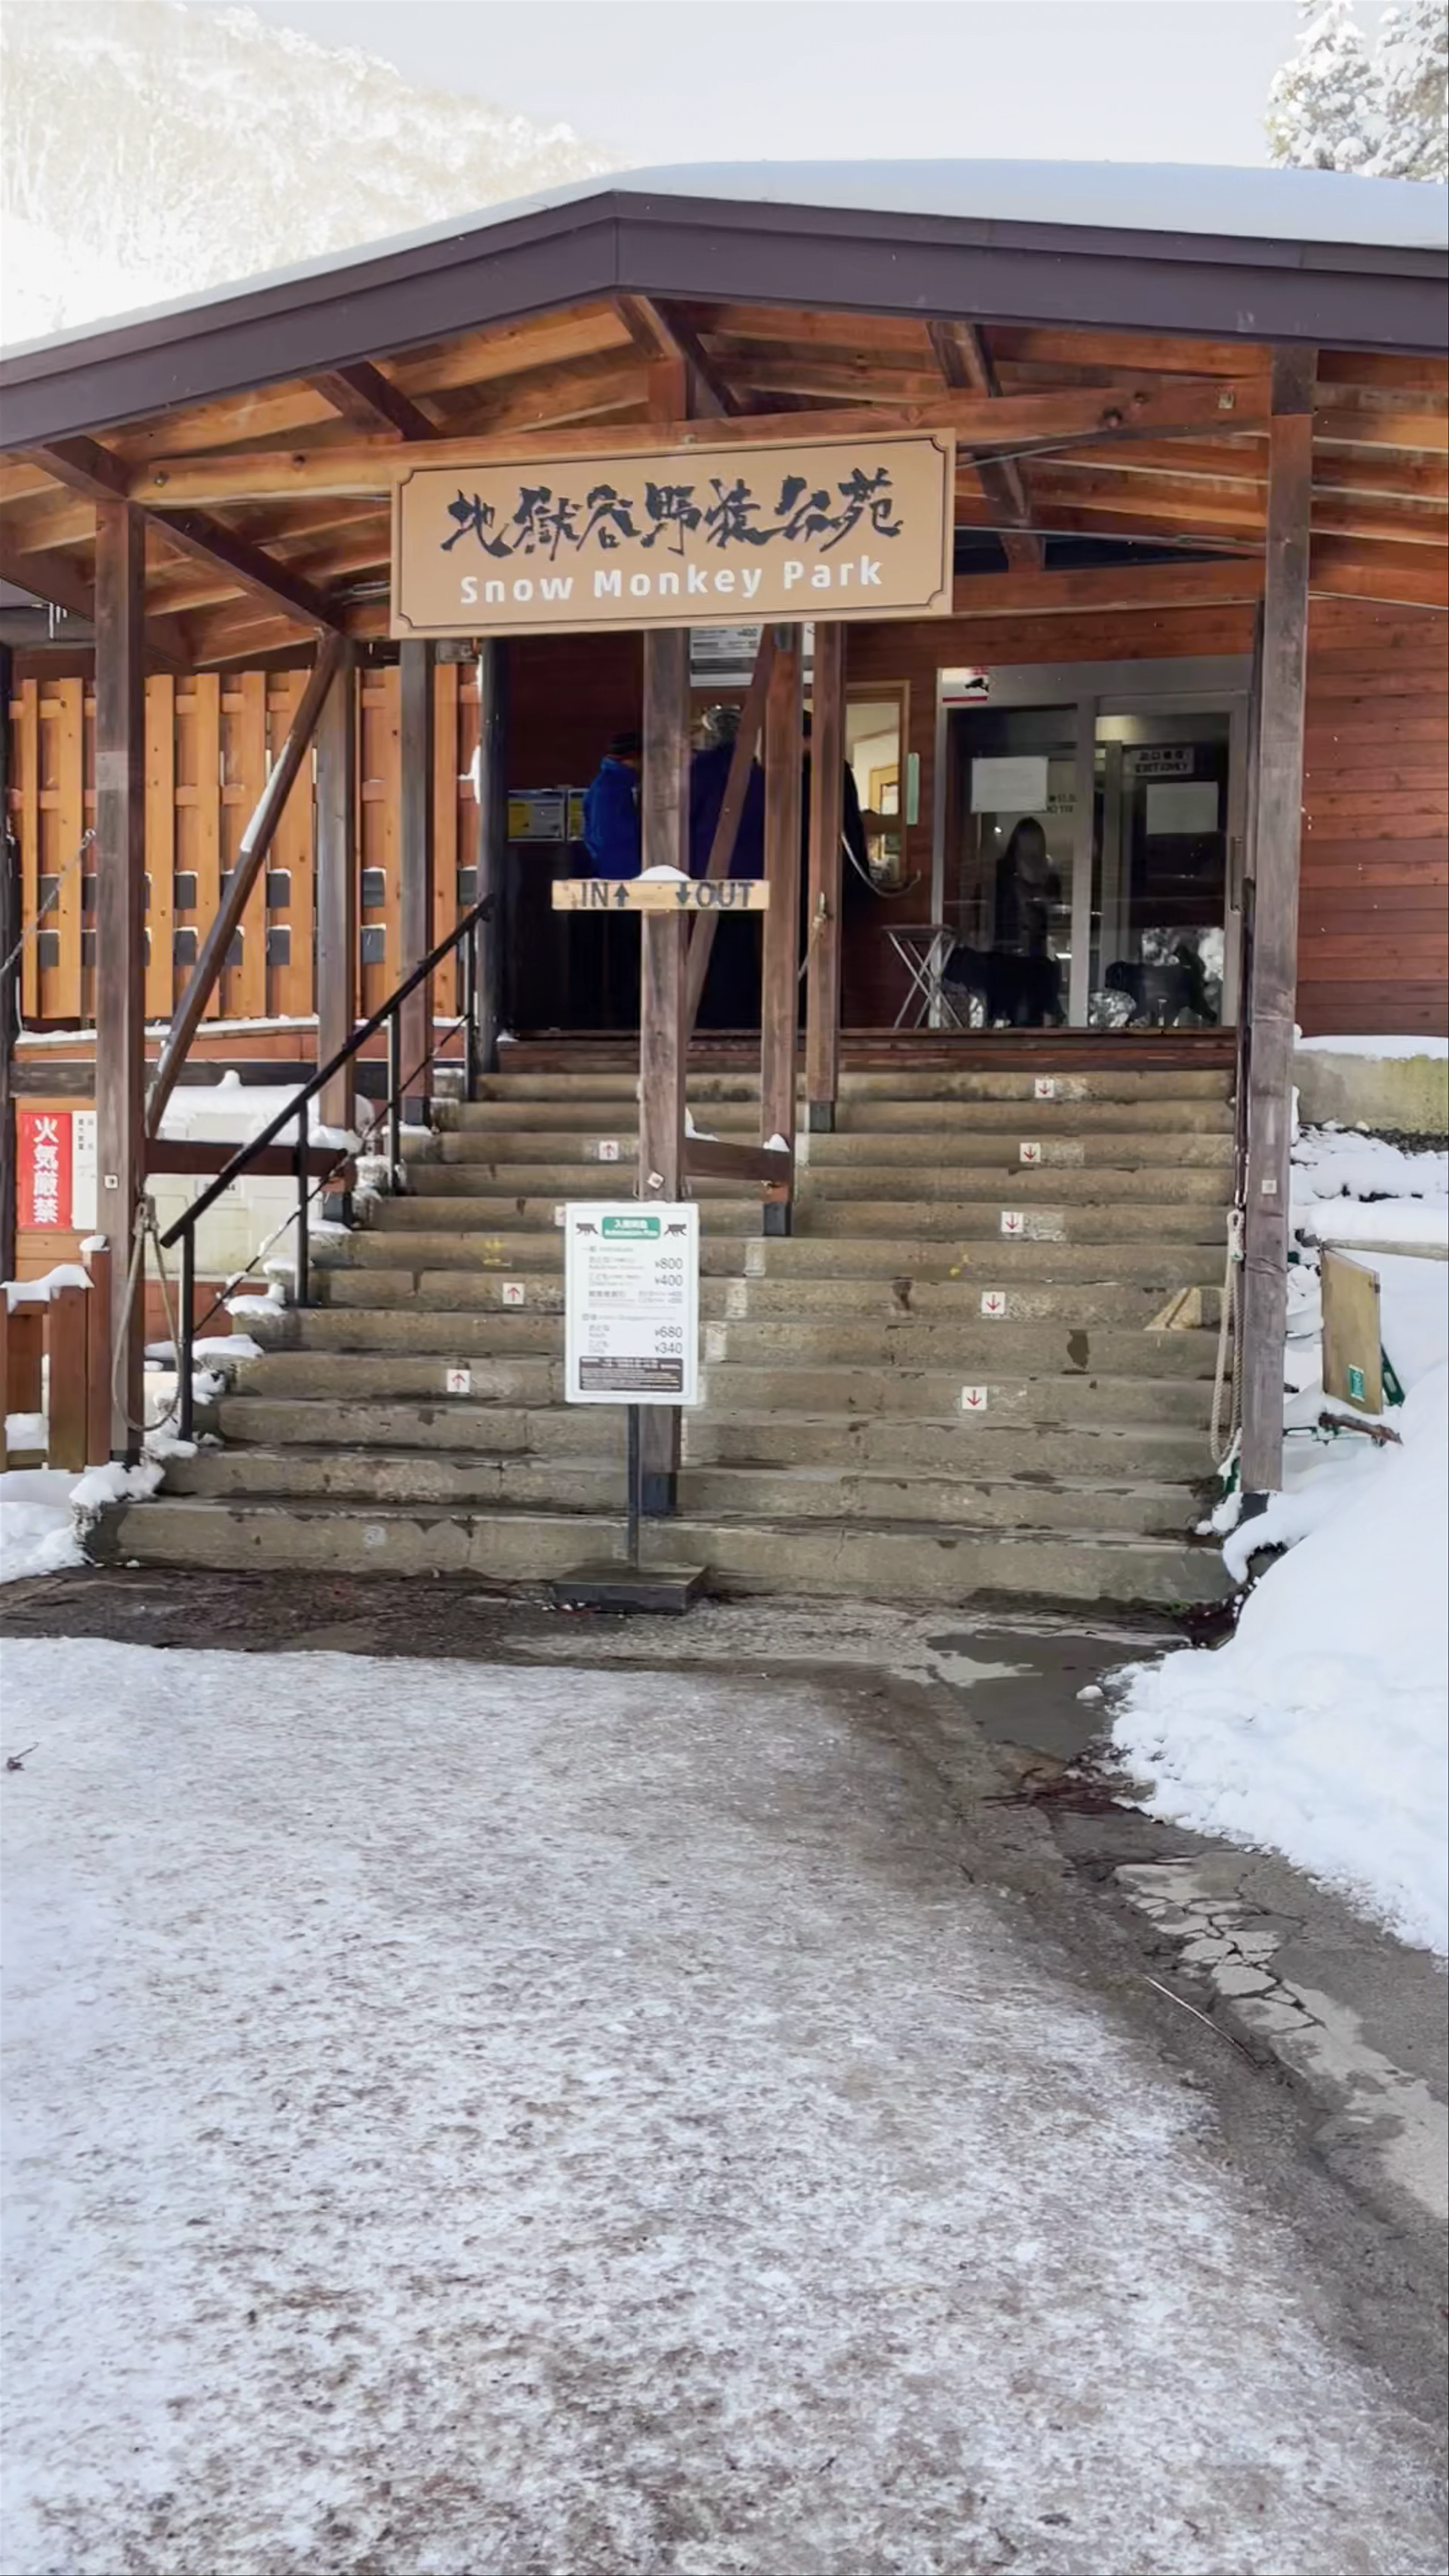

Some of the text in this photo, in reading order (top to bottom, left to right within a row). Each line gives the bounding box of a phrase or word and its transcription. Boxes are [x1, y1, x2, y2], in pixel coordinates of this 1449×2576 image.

[461, 555, 884, 604] Snow Monkey Park
[581, 882, 609, 907] IN
[695, 881, 754, 908] OUT
[655, 1257, 683, 1270] ¥800
[655, 1275, 683, 1287] ¥400
[655, 1342, 683, 1354] ¥340
